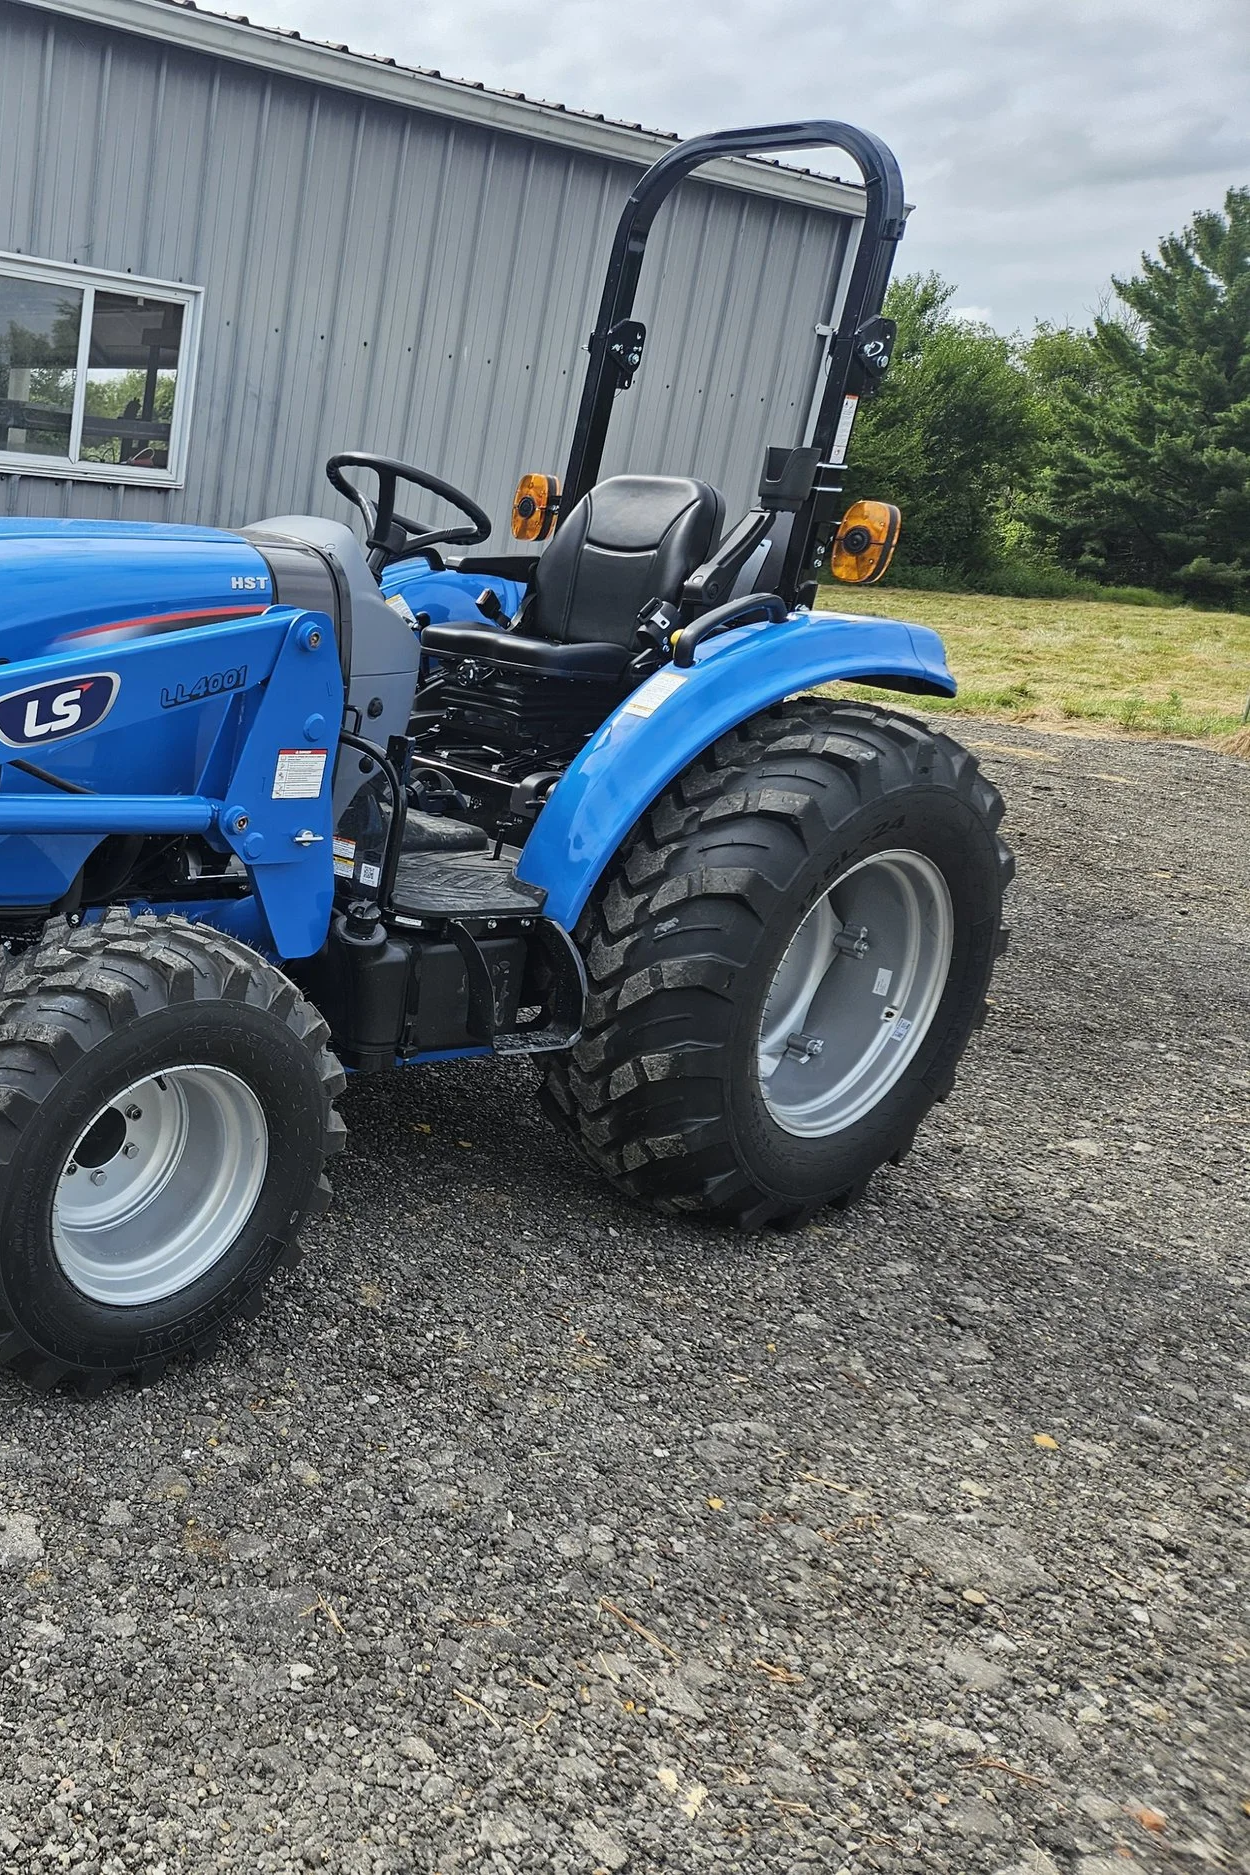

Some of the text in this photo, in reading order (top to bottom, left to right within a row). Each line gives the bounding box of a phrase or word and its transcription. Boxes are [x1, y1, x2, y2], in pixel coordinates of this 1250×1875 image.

[231, 576, 269, 590] HST
[160, 664, 247, 708] LL4001
[24, 689, 82, 738] LS
